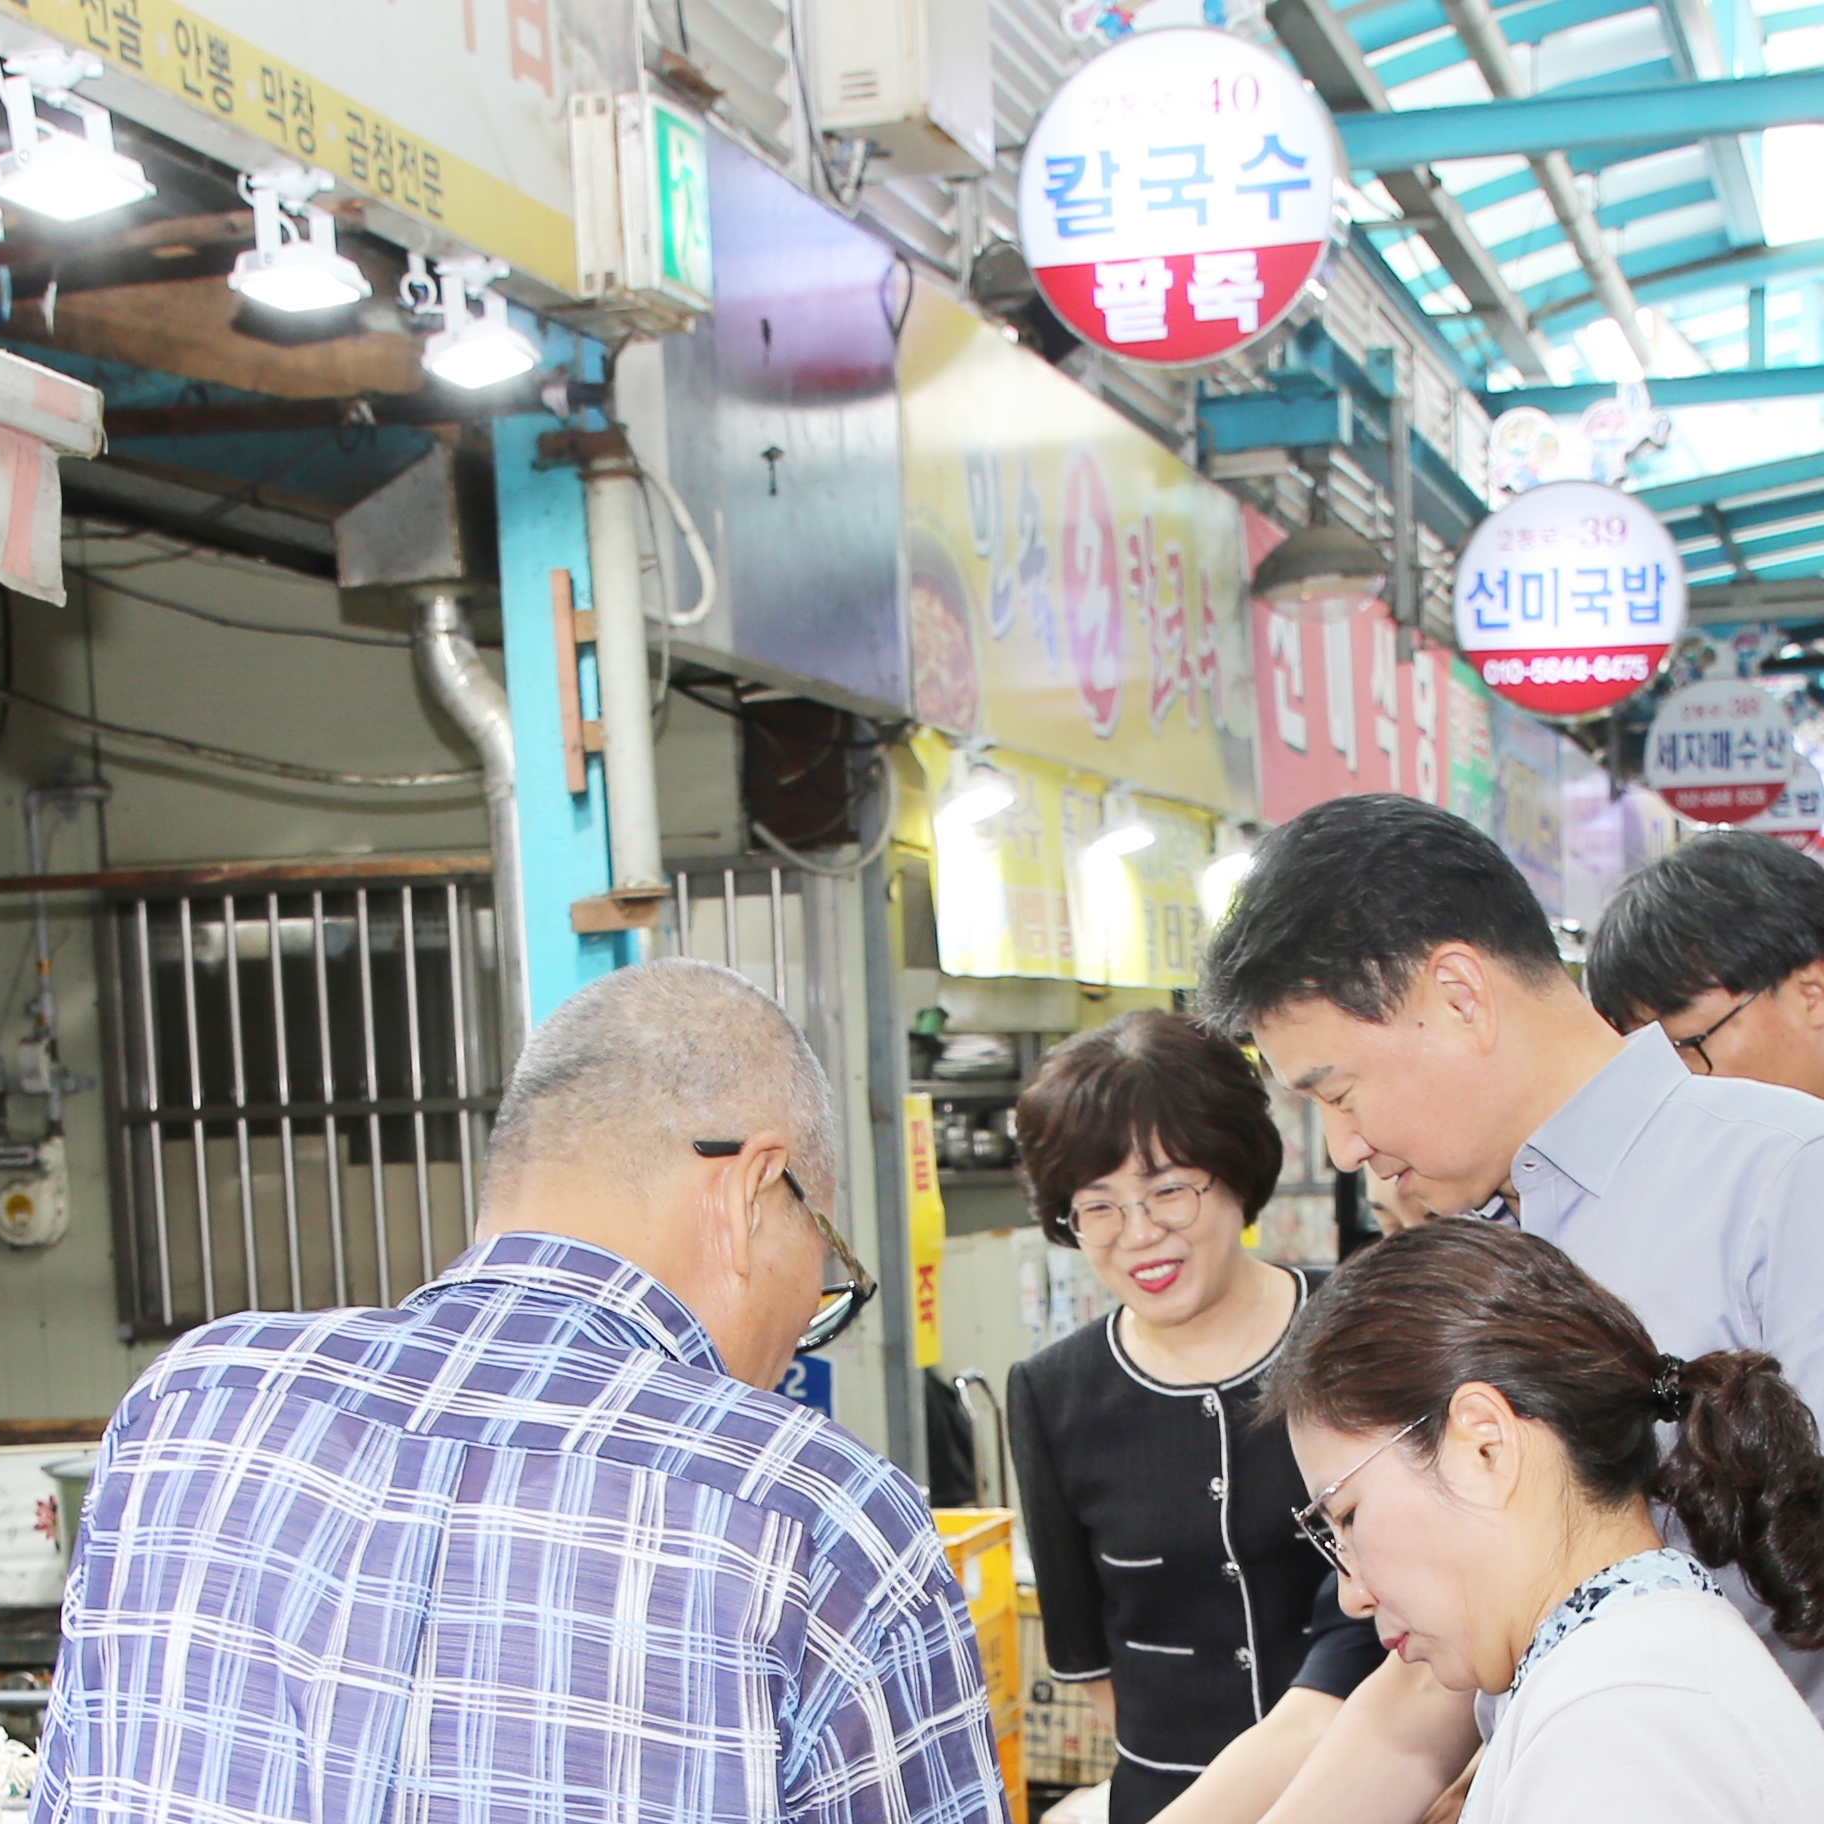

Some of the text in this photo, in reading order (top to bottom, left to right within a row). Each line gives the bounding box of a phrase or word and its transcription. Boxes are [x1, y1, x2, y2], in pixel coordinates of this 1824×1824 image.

[261, 66, 316, 156] 막창
[346, 109, 444, 220] 곱창전문
[1043, 132, 1311, 239] 칼국수
[1466, 563, 1667, 630] 선미국밥
[1655, 727, 1788, 773] 세자매수산
